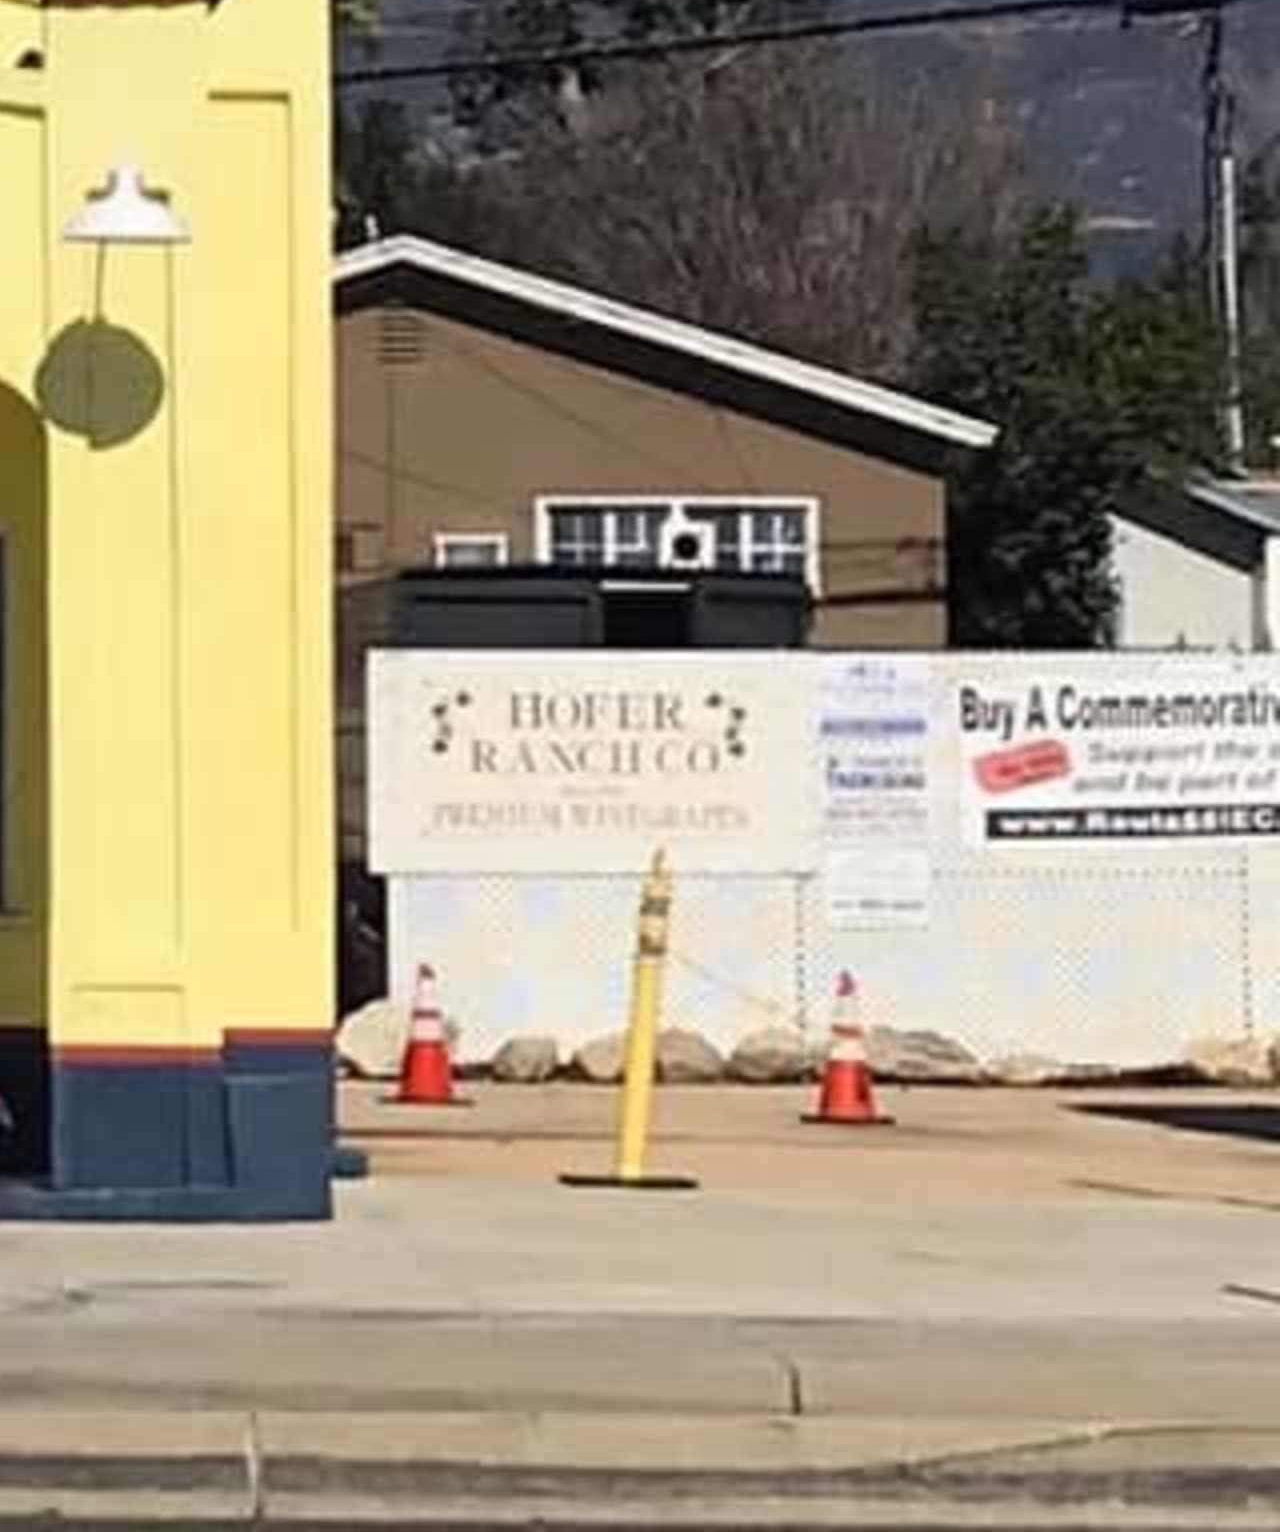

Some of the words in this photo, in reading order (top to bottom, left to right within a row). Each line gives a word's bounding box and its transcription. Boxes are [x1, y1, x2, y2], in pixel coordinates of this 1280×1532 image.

[510, 691, 685, 730] HOFER
[959, 686, 1015, 741] Buy
[1025, 686, 1049, 730] A
[471, 739, 640, 773] RANCH
[654, 739, 720, 773] CO
[1087, 741, 1206, 765] Support
